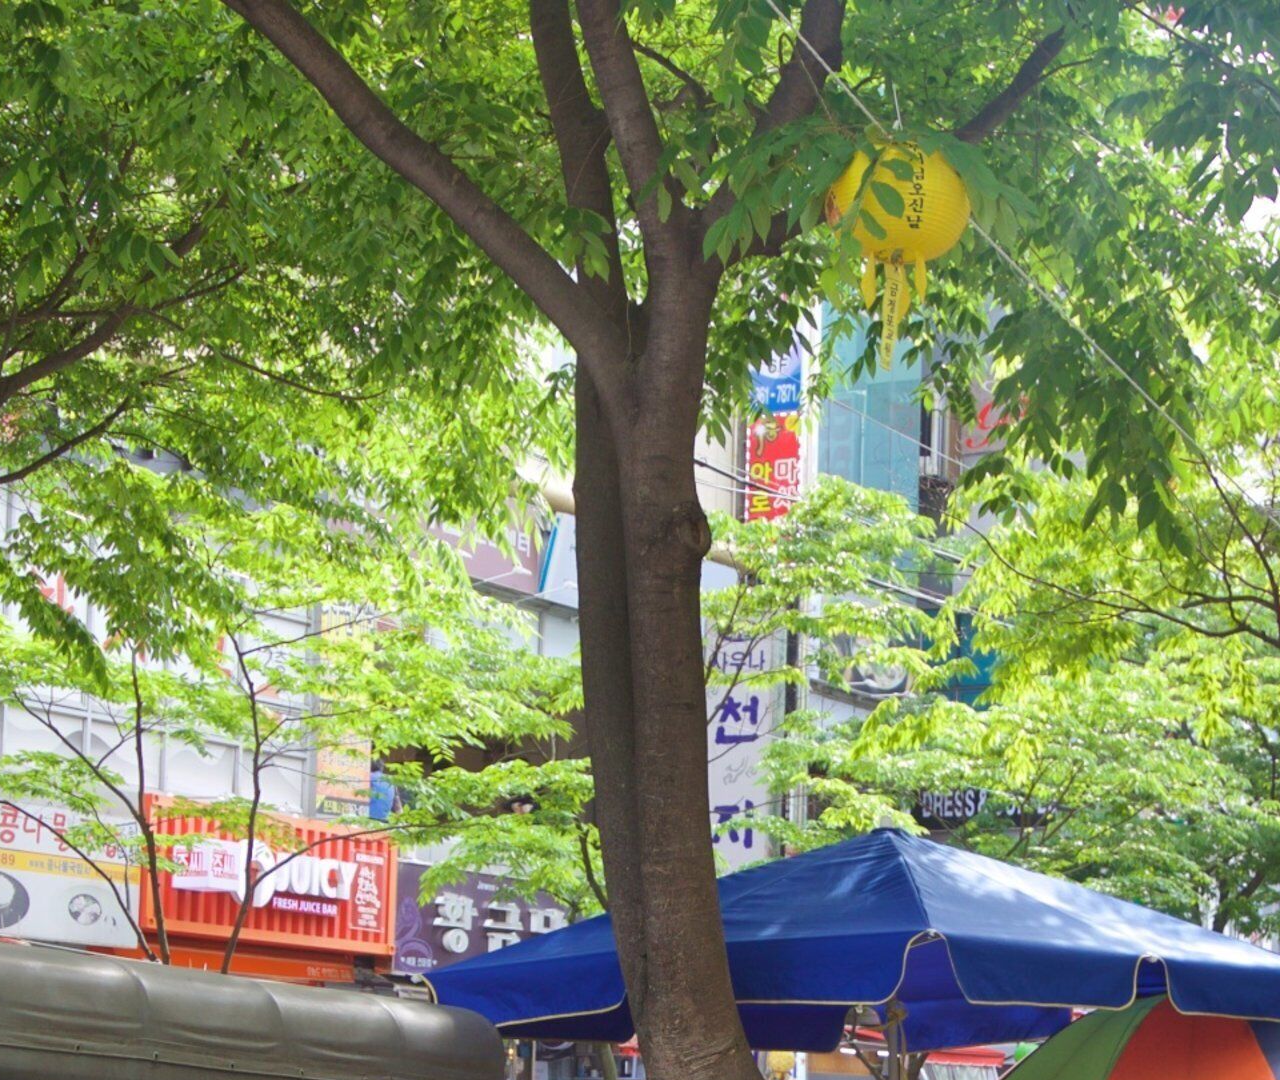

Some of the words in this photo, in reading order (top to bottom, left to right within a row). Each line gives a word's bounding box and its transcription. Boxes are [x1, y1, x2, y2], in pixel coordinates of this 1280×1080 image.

[275, 853, 359, 900] JUICY
[273, 897, 297, 912] FRESH
[298, 900, 321, 914] JUICE
[322, 903, 338, 916] BAR
